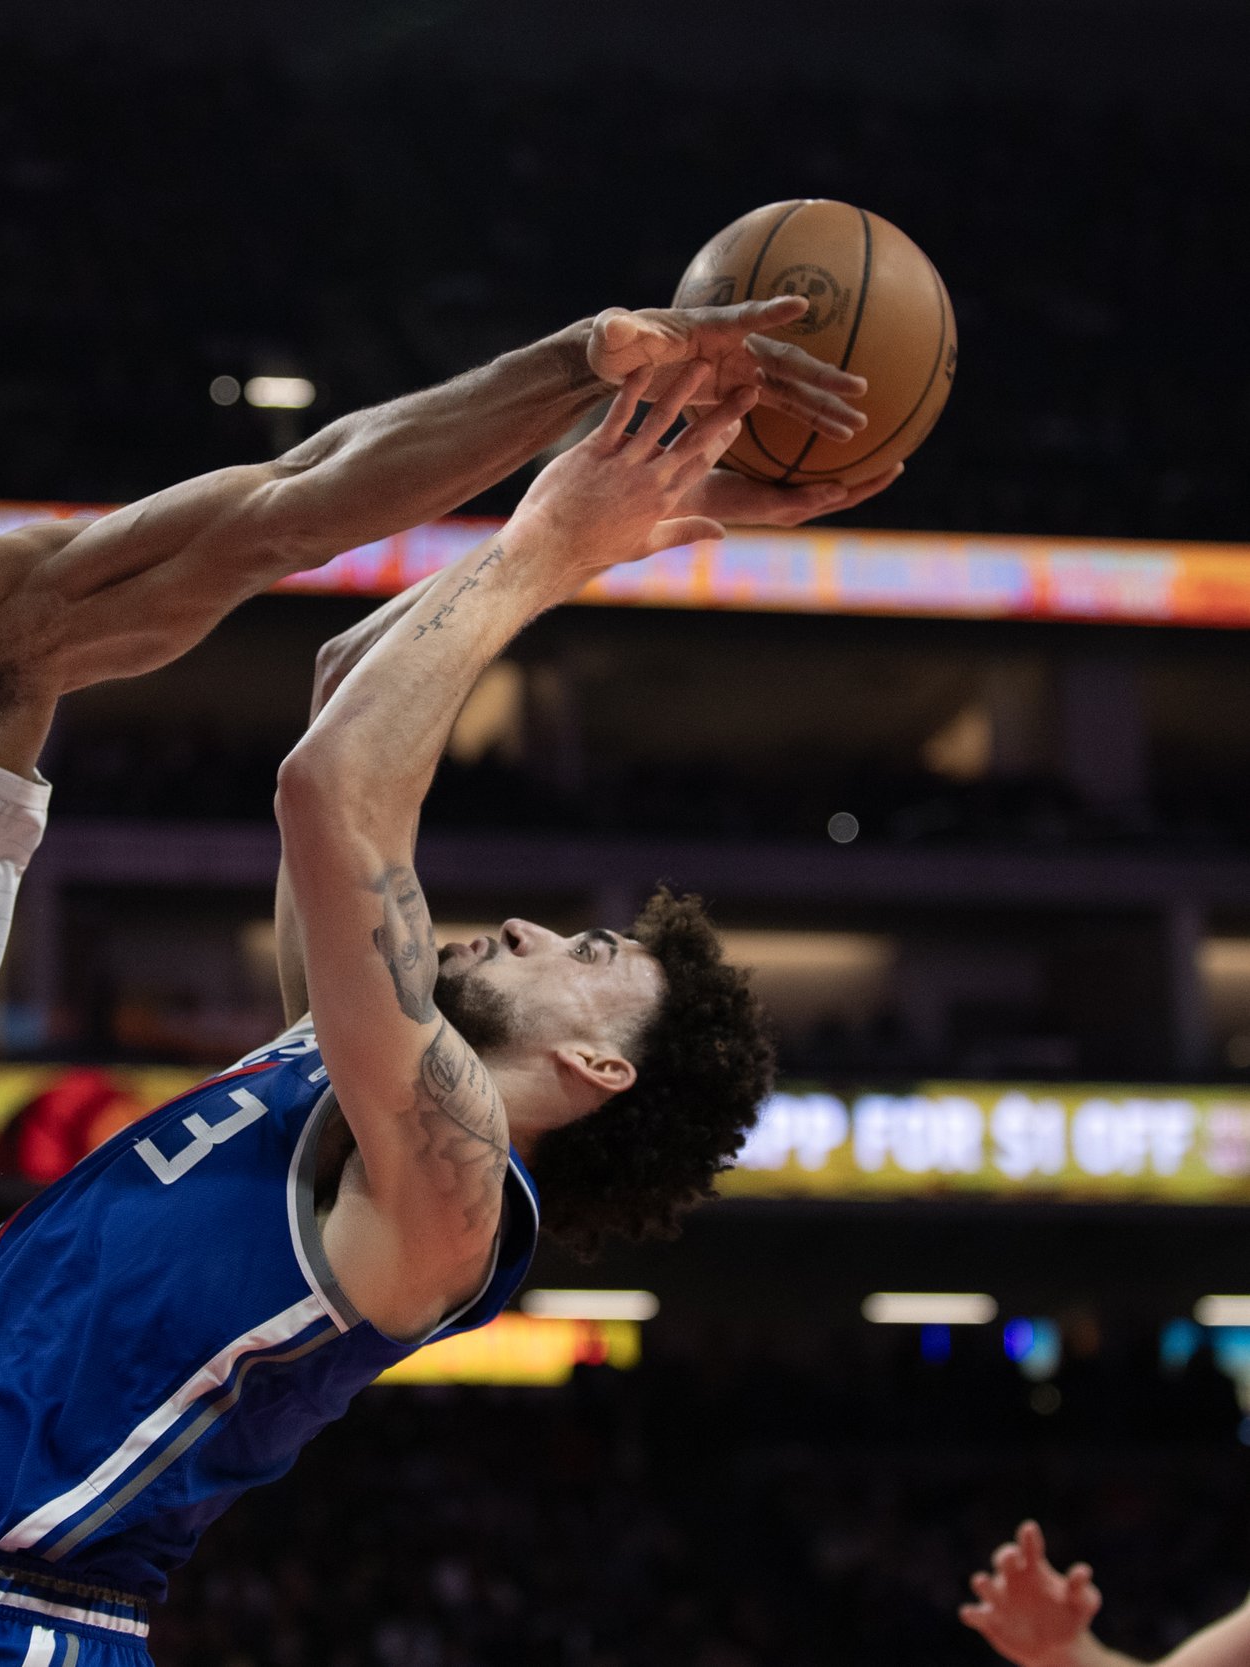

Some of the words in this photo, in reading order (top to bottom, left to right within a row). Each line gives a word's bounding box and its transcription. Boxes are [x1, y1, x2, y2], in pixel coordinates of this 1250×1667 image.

[133, 1087, 270, 1186] 3
[854, 1094, 984, 1174] FOR
[1072, 1098, 1197, 1177] OFF
